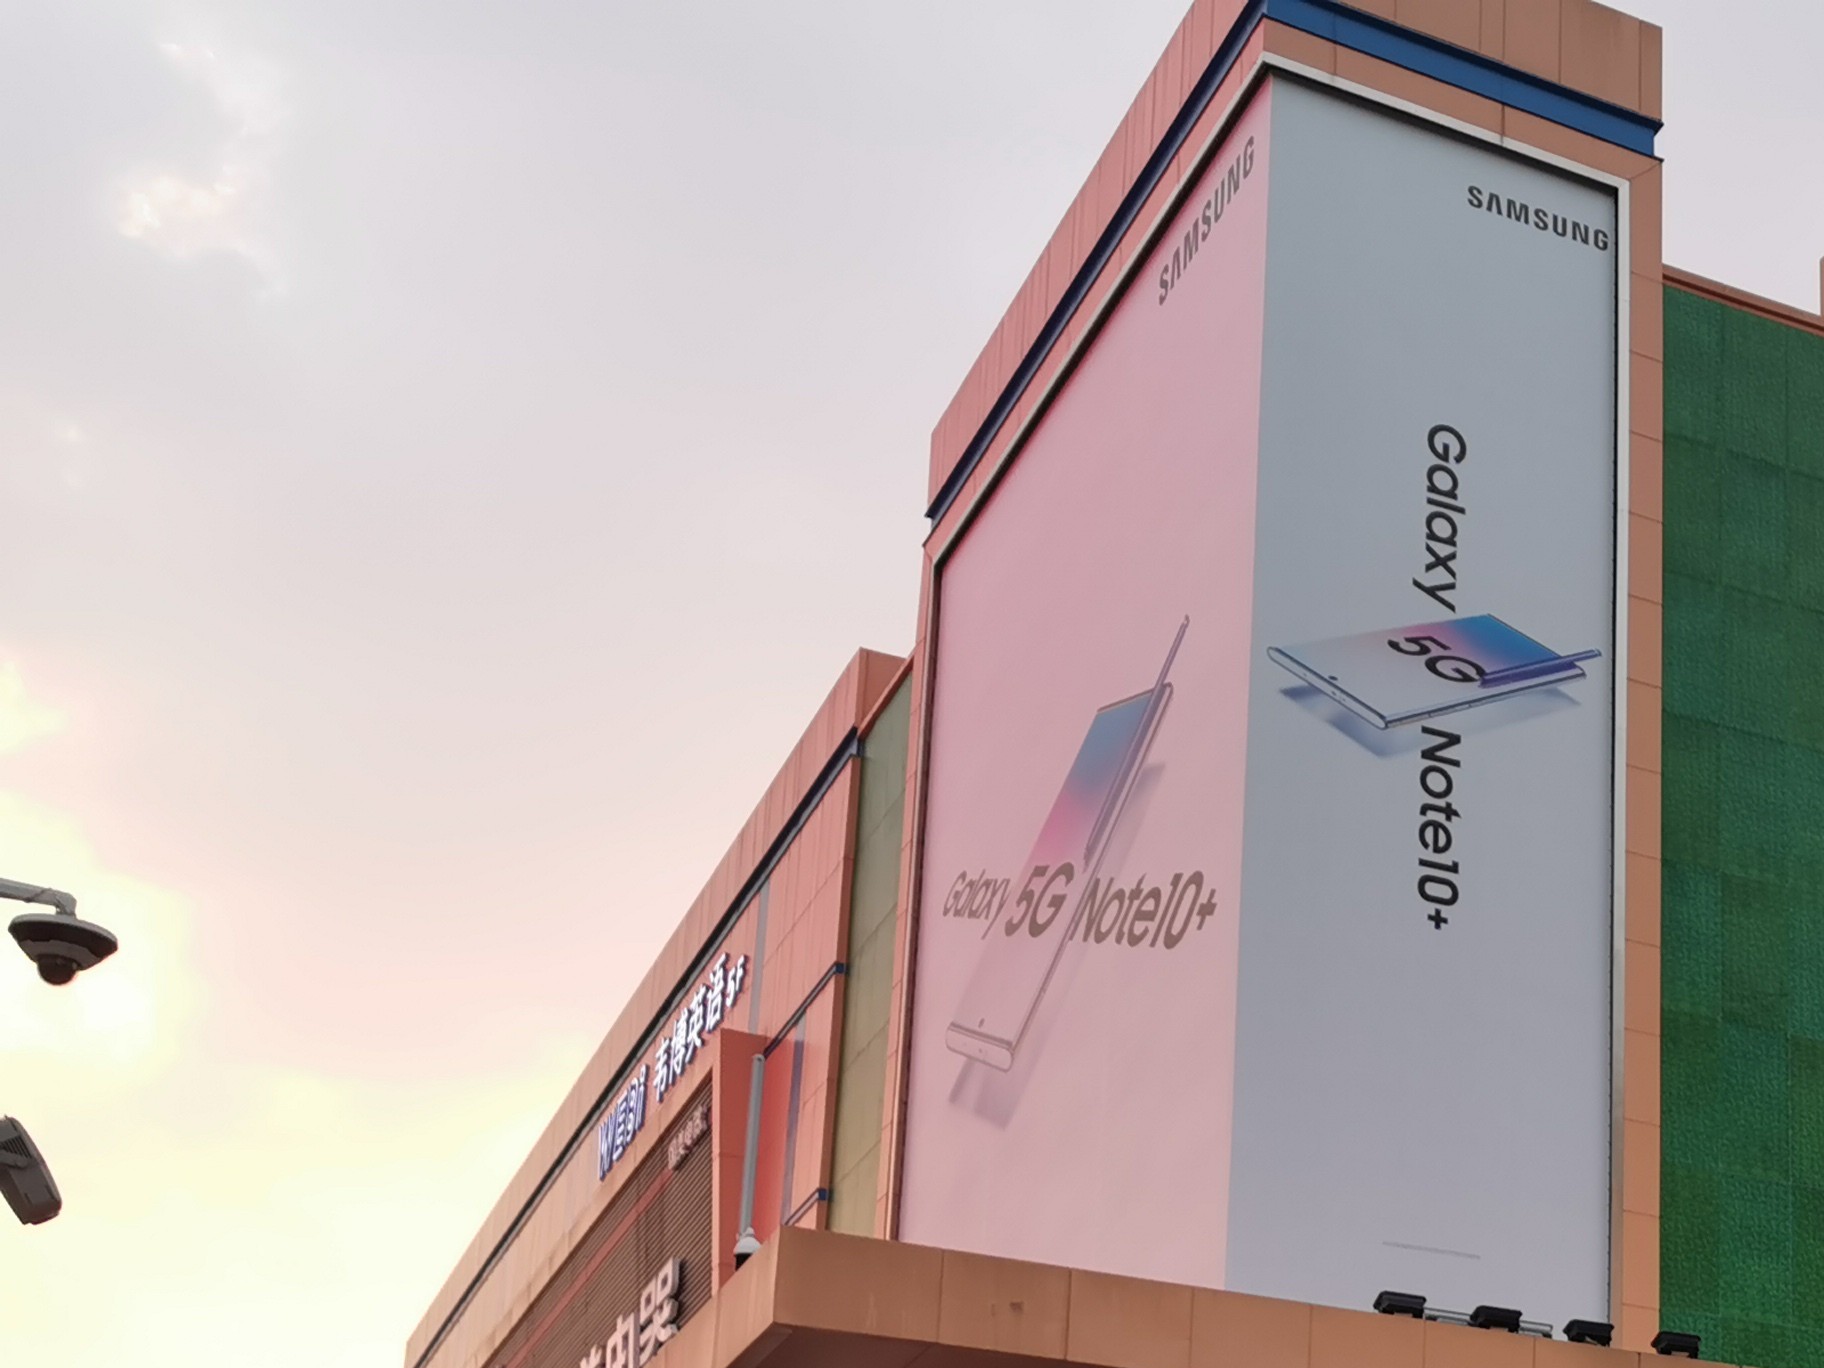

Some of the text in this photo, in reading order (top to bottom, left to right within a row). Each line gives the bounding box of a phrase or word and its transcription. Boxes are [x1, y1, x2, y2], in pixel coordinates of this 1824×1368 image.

[1159, 136, 1255, 305] SAMSUNG
[1467, 185, 1609, 251] SAMSUNG
[1388, 425, 1487, 930] Galaxy 5G Note10+
[943, 863, 1217, 949] Galaxy 5G Note10+
[653, 953, 728, 1102] 韦博英语
